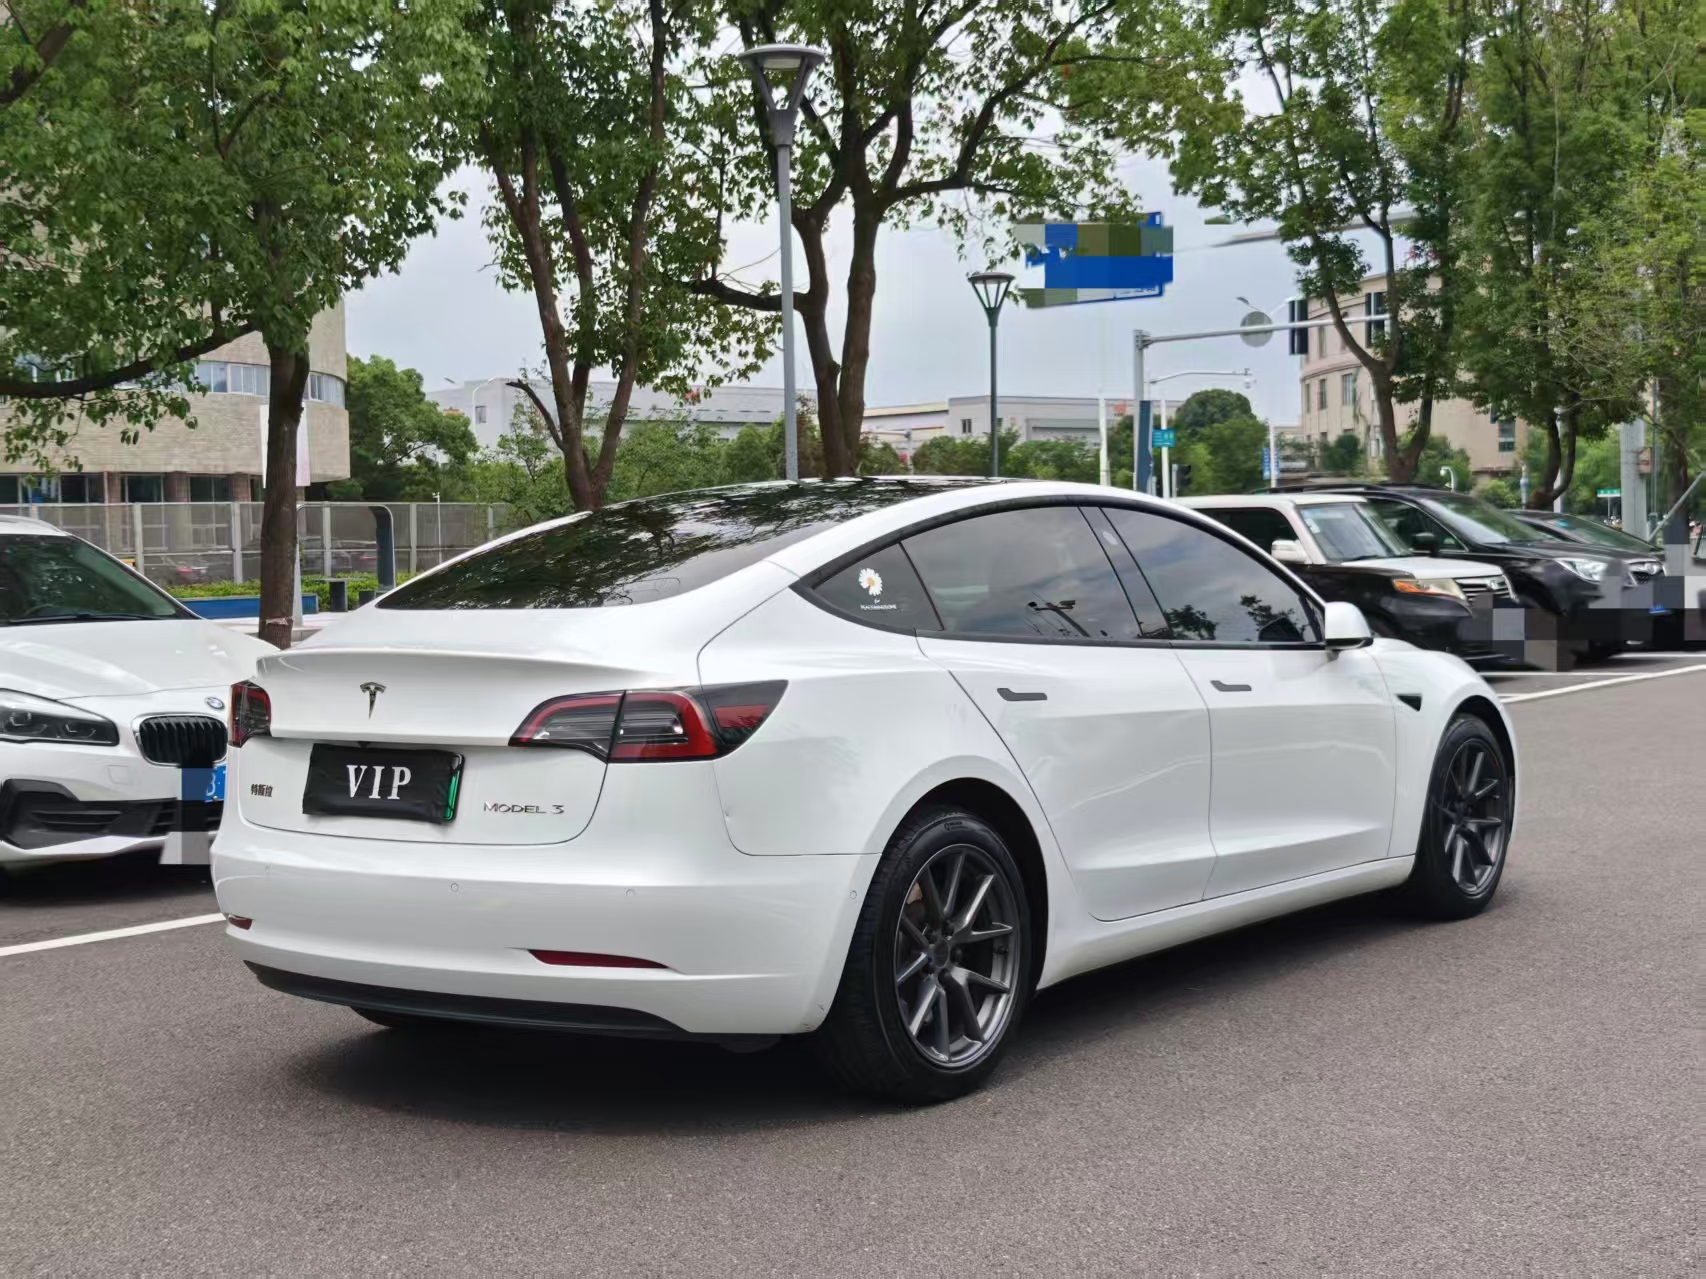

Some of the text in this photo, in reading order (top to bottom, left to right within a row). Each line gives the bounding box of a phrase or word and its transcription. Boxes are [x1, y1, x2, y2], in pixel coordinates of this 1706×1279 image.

[346, 764, 412, 800] VIP
[251, 784, 274, 798] 特斯拉
[483, 801, 565, 815] MODEL 3
